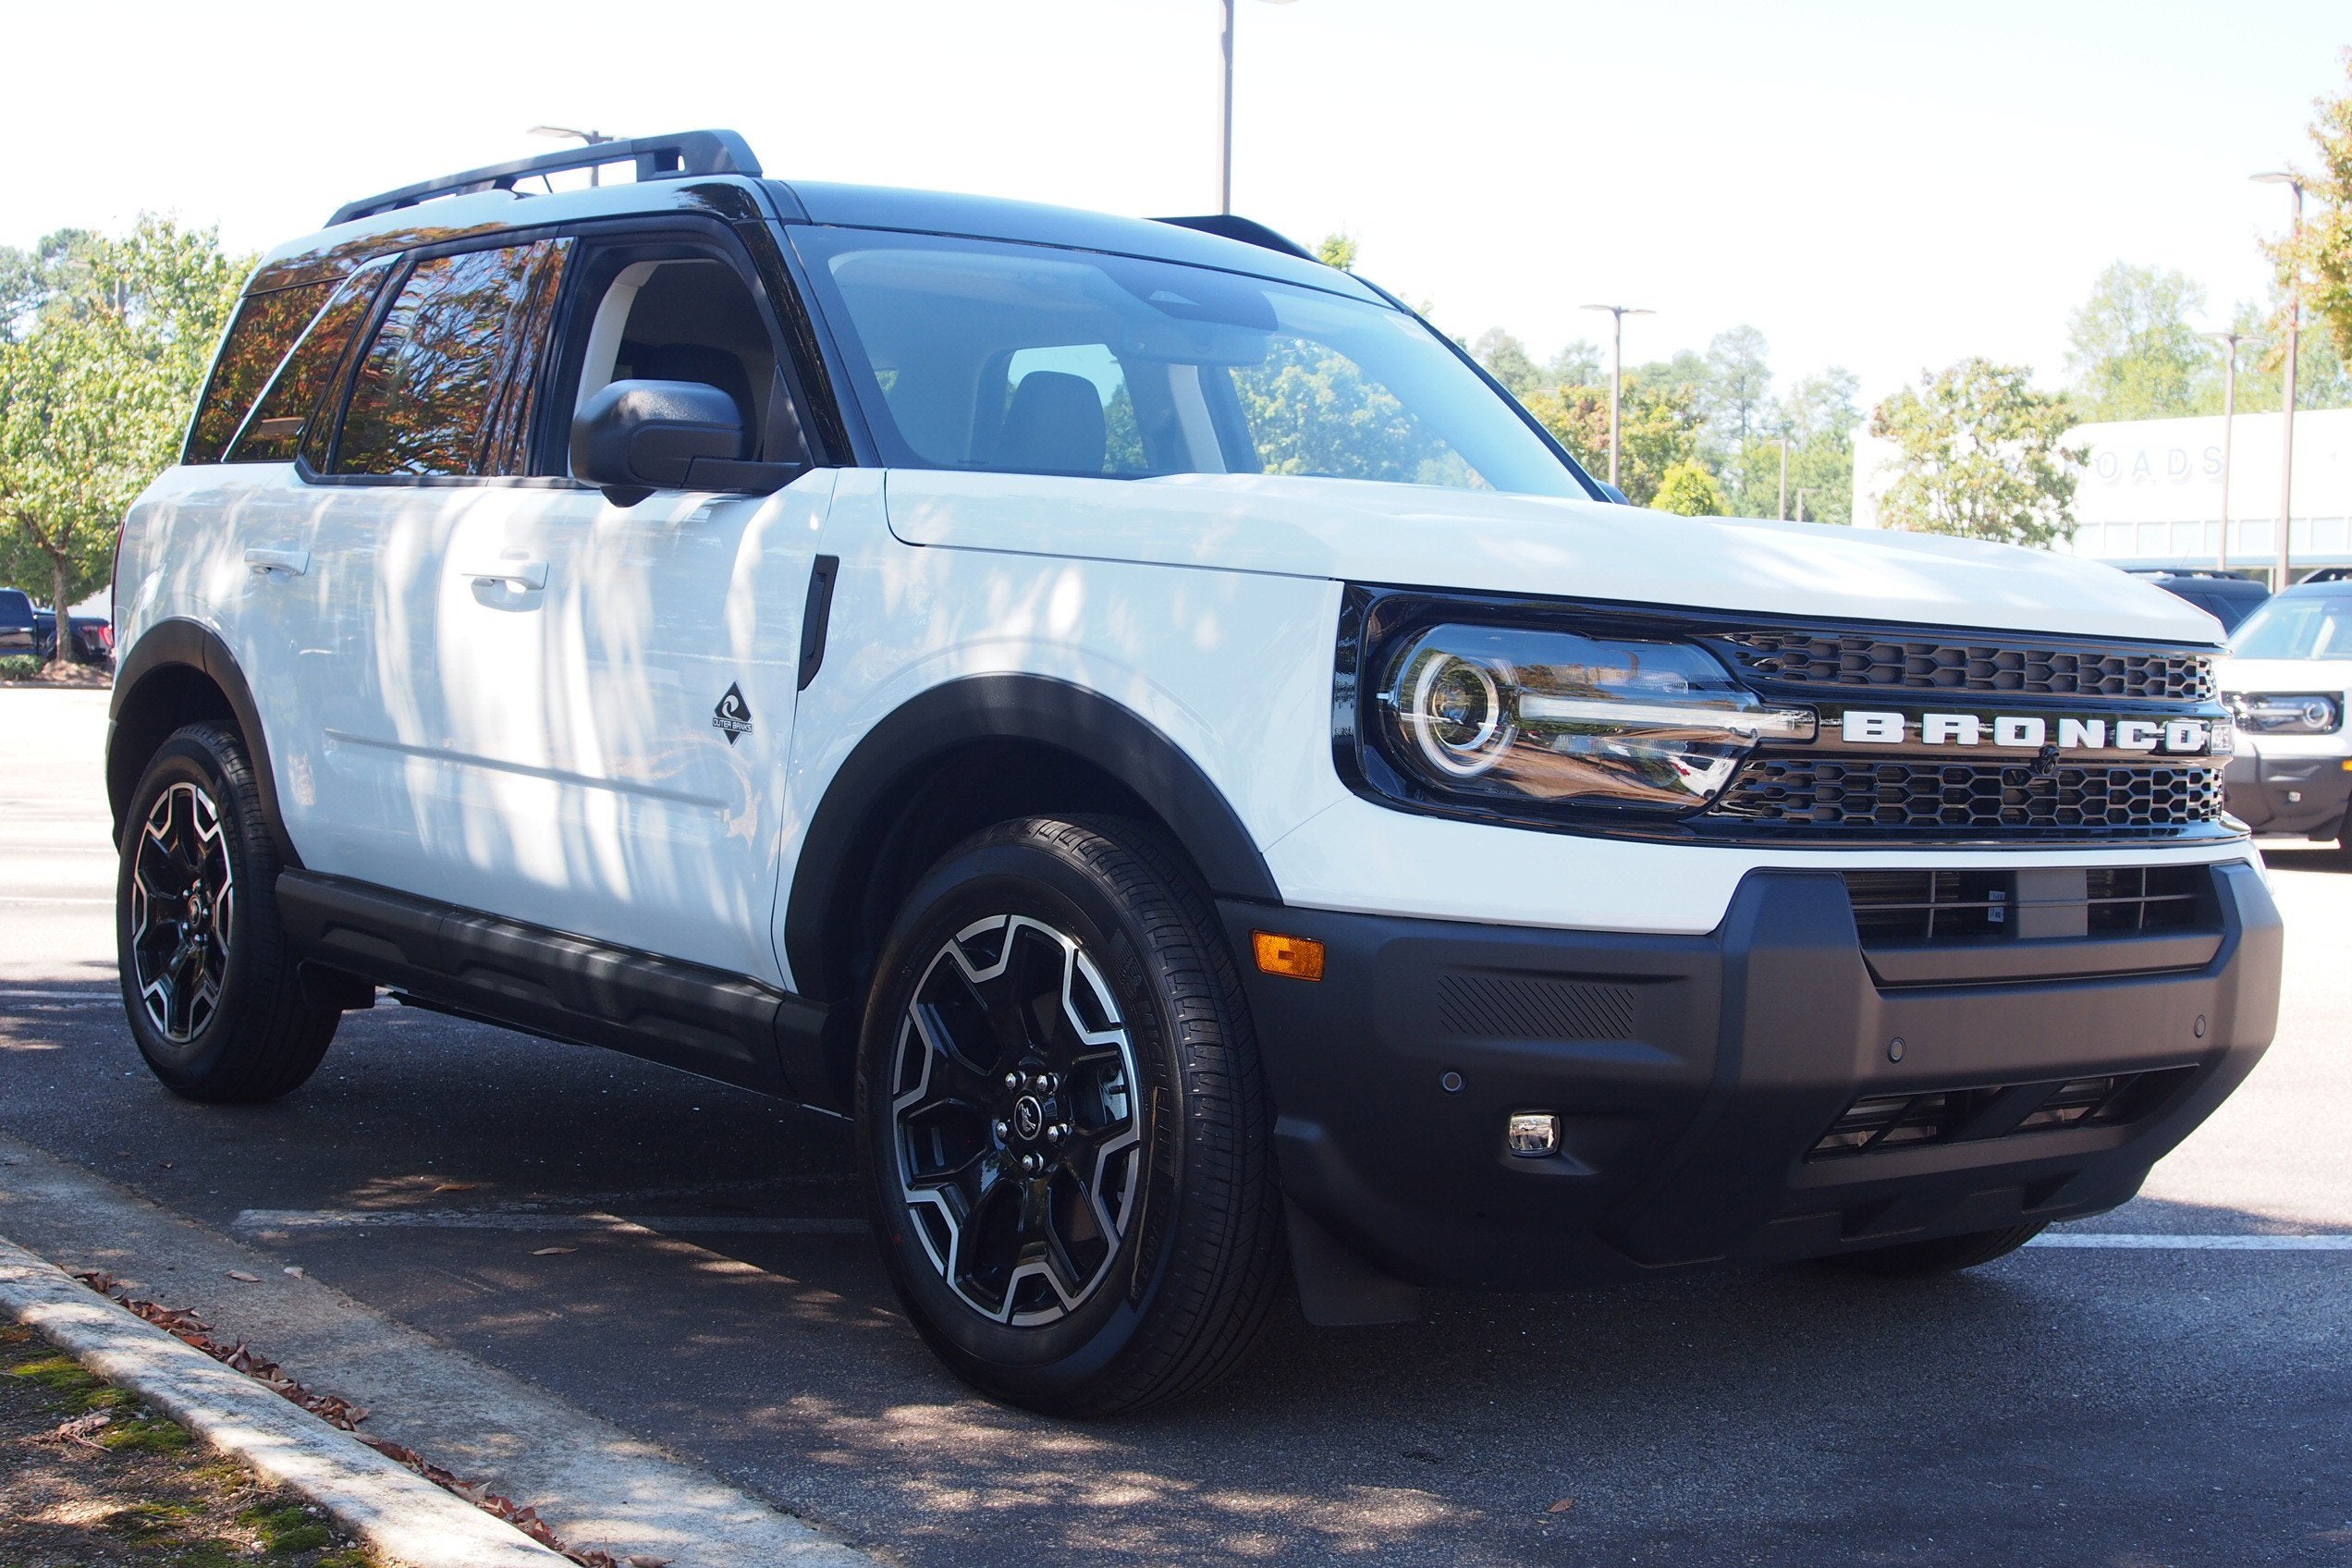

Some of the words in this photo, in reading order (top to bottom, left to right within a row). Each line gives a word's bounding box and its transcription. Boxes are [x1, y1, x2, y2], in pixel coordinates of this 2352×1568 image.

[713, 718, 731, 729] OUTER
[732, 721, 752, 732] BANKS
[1843, 710, 2204, 753] BRONCO
